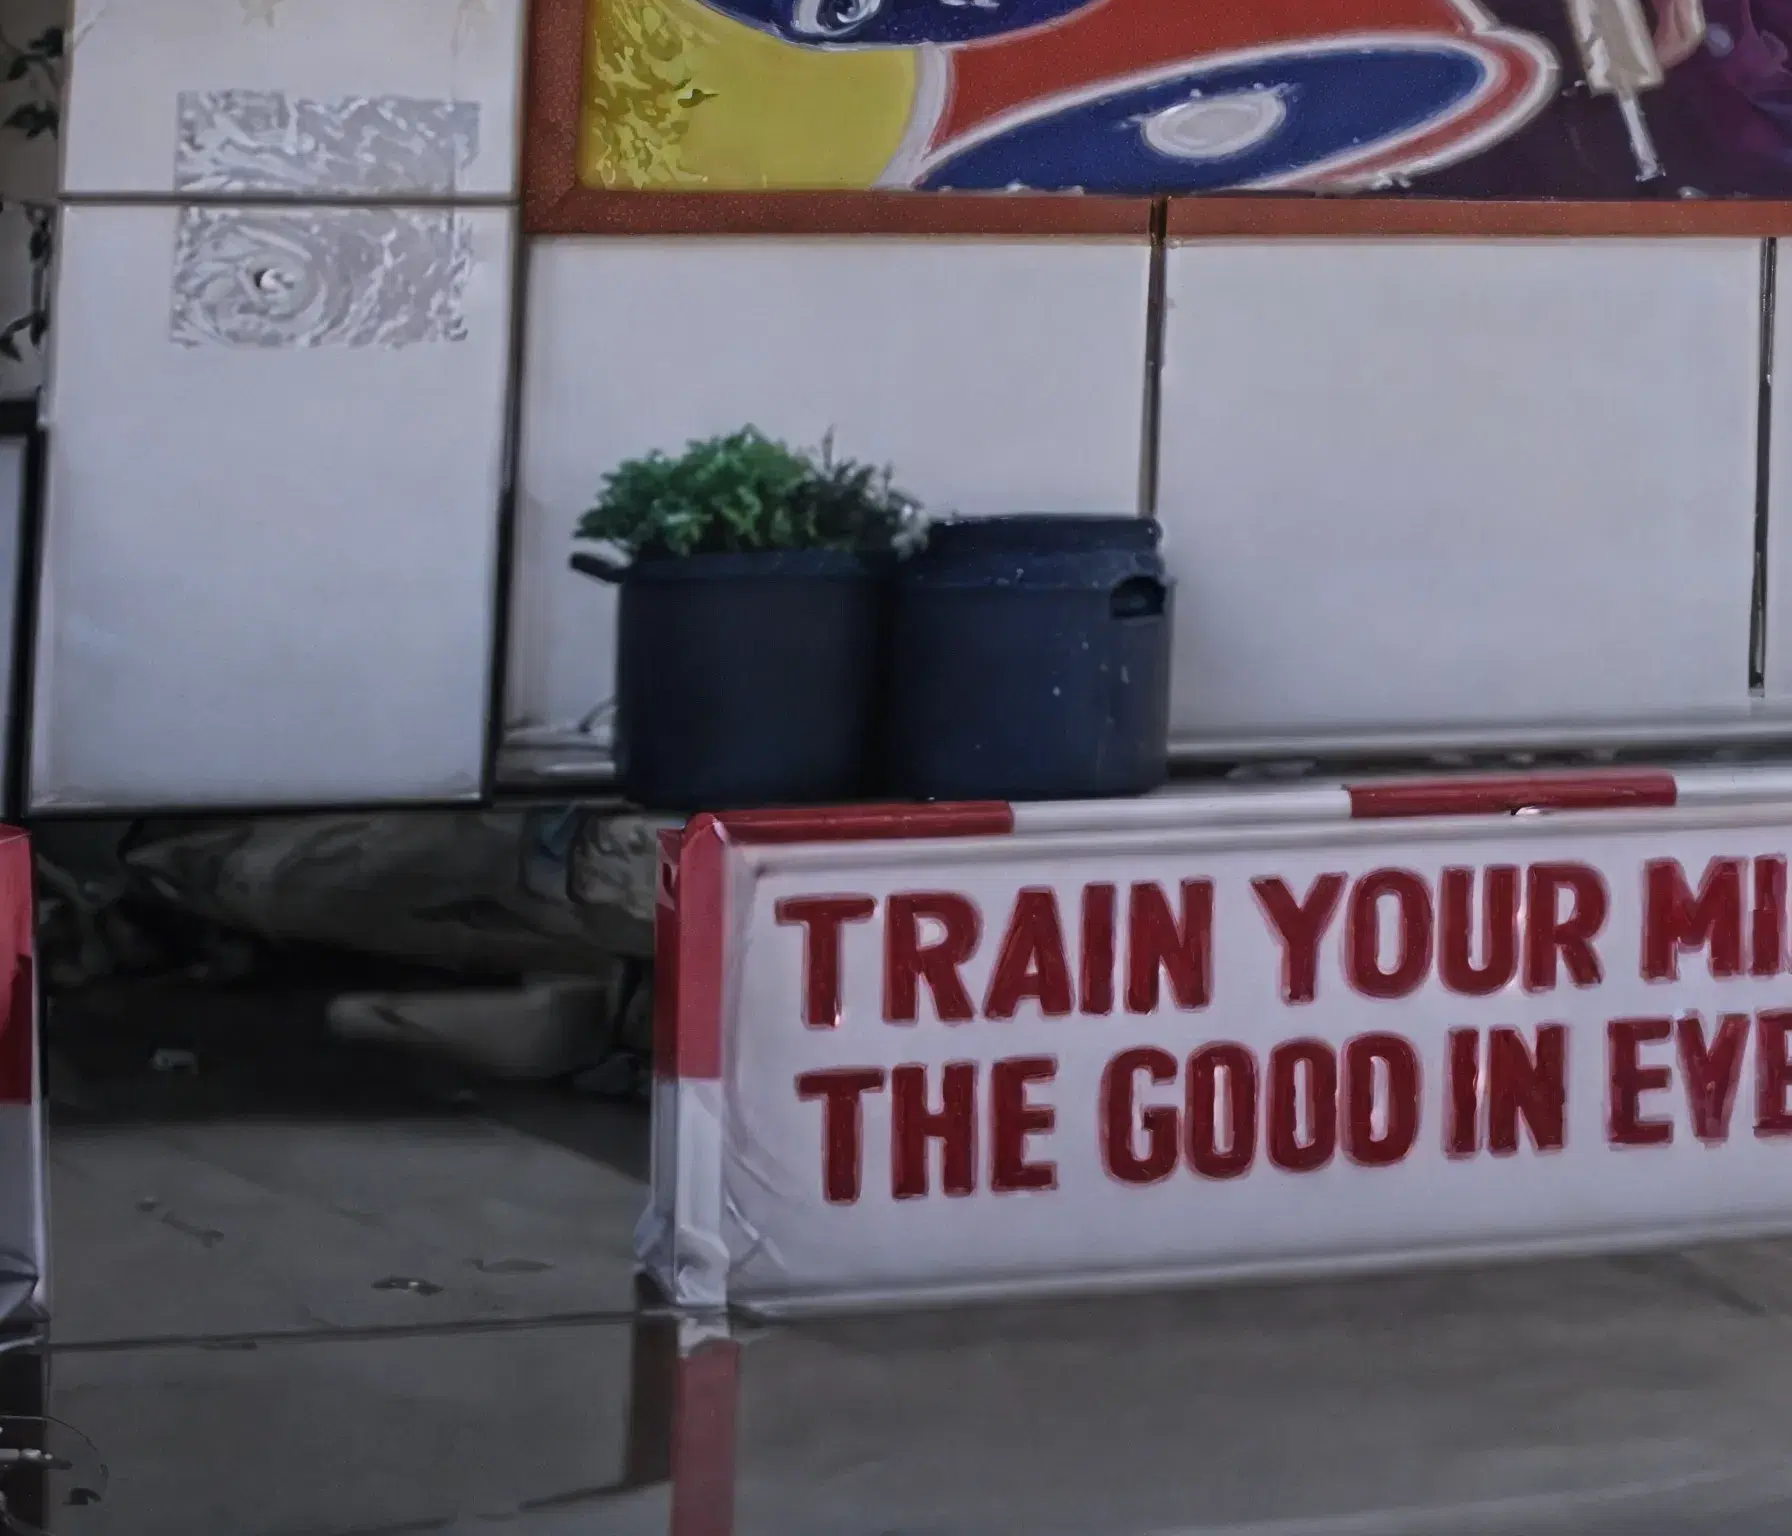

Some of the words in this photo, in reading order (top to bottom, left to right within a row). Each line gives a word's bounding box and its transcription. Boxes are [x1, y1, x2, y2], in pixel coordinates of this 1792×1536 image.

[775, 876, 1214, 1028] TRAIN
[1250, 861, 1611, 1006] YOUR
[795, 1054, 1060, 1205] THE
[1100, 1031, 1422, 1185] GOOD
[1443, 1021, 1570, 1160] IN
